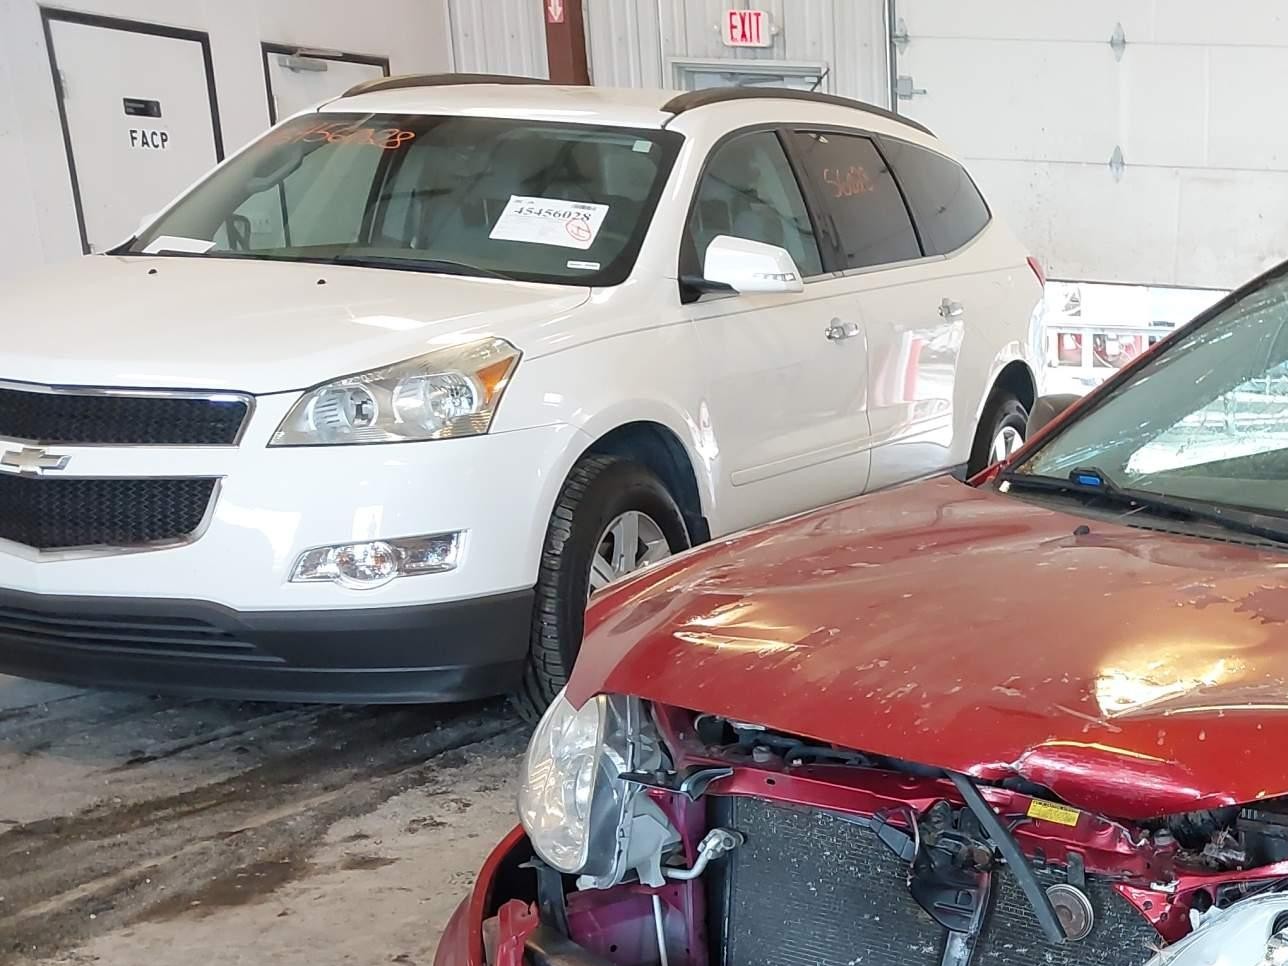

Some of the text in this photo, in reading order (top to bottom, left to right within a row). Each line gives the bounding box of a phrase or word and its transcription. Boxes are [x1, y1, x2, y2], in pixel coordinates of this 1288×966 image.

[729, 11, 762, 43] EXIT
[129, 129, 169, 149] FACP
[513, 206, 592, 221] 45456028
